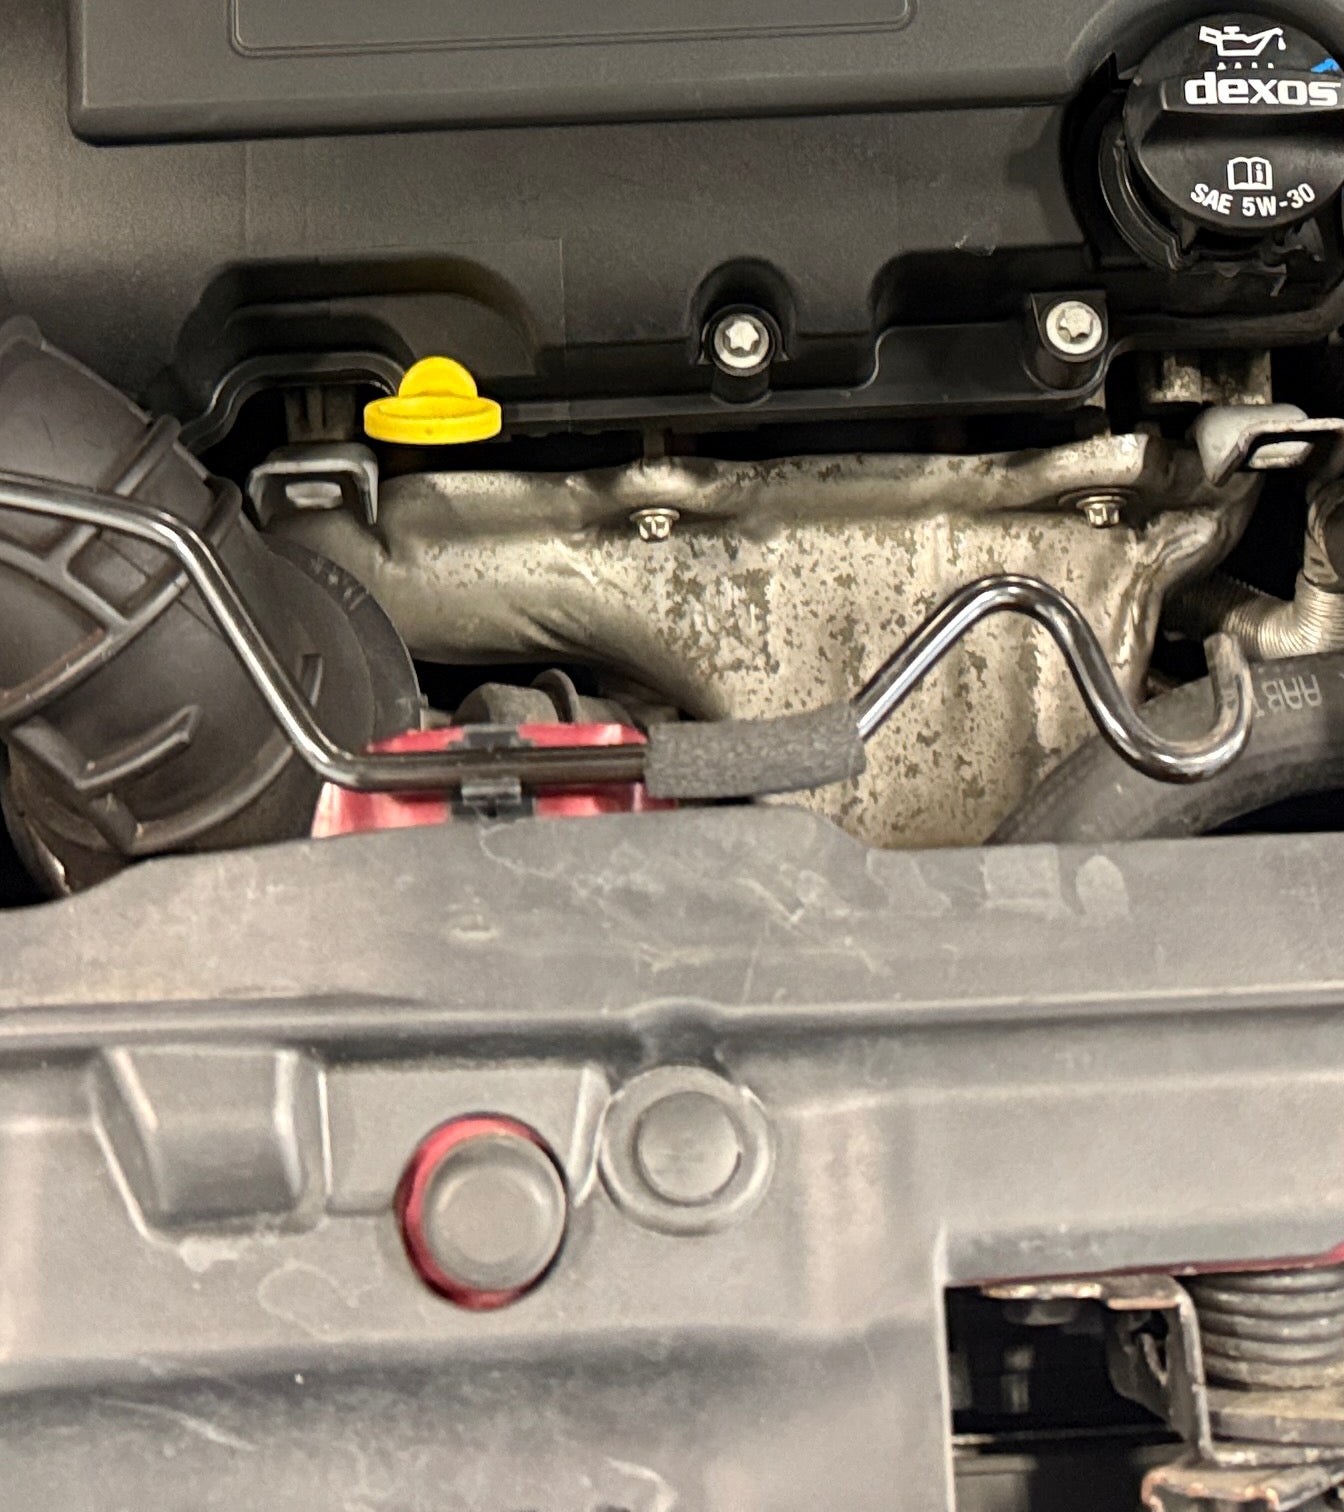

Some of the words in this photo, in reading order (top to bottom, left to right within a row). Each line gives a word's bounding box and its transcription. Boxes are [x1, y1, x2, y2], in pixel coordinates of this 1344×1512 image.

[1184, 72, 1342, 106] dexos
[1190, 183, 1233, 215] SAE
[1242, 183, 1316, 217] 5W-30
